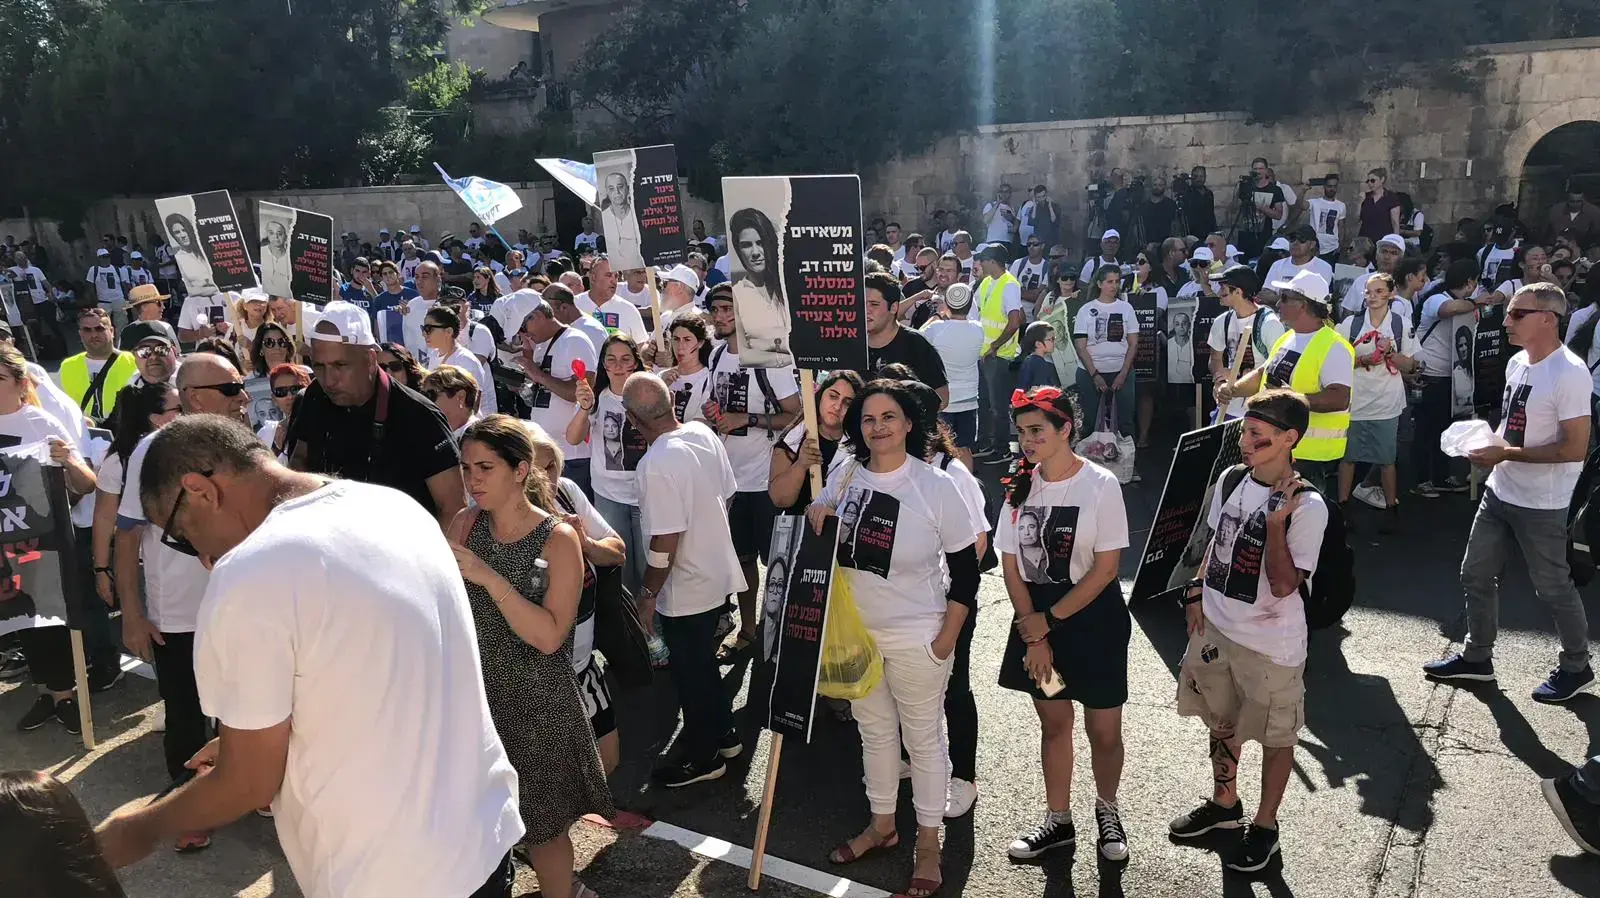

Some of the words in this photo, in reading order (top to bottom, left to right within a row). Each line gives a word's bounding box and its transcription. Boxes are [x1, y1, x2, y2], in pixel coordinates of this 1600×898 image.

[640, 176, 652, 186] דב,
[654, 174, 672, 183] שדה
[655, 184, 674, 193] צינור
[649, 194, 676, 206] החמצן
[664, 205, 676, 213] של
[198, 214, 232, 226] משאירים
[642, 218, 666, 228] תנתקו
[220, 232, 236, 240] שדה
[790, 226, 852, 238] משאירים
[310, 236, 327, 244] שדה
[832, 243, 854, 254] את
[799, 260, 820, 274] דב,
[823, 260, 854, 272] שדה
[804, 276, 856, 288] כמסלול
[801, 292, 856, 306] להשכלה
[796, 310, 832, 322] צעירי
[836, 308, 856, 322] של
[820, 326, 857, 338] אילת!
[1478, 330, 1500, 339] משאירים
[800, 568, 826, 584] נתניהו,
[812, 586, 824, 602] אל
[788, 603, 799, 618] לנו
[800, 606, 821, 622] תפגע
